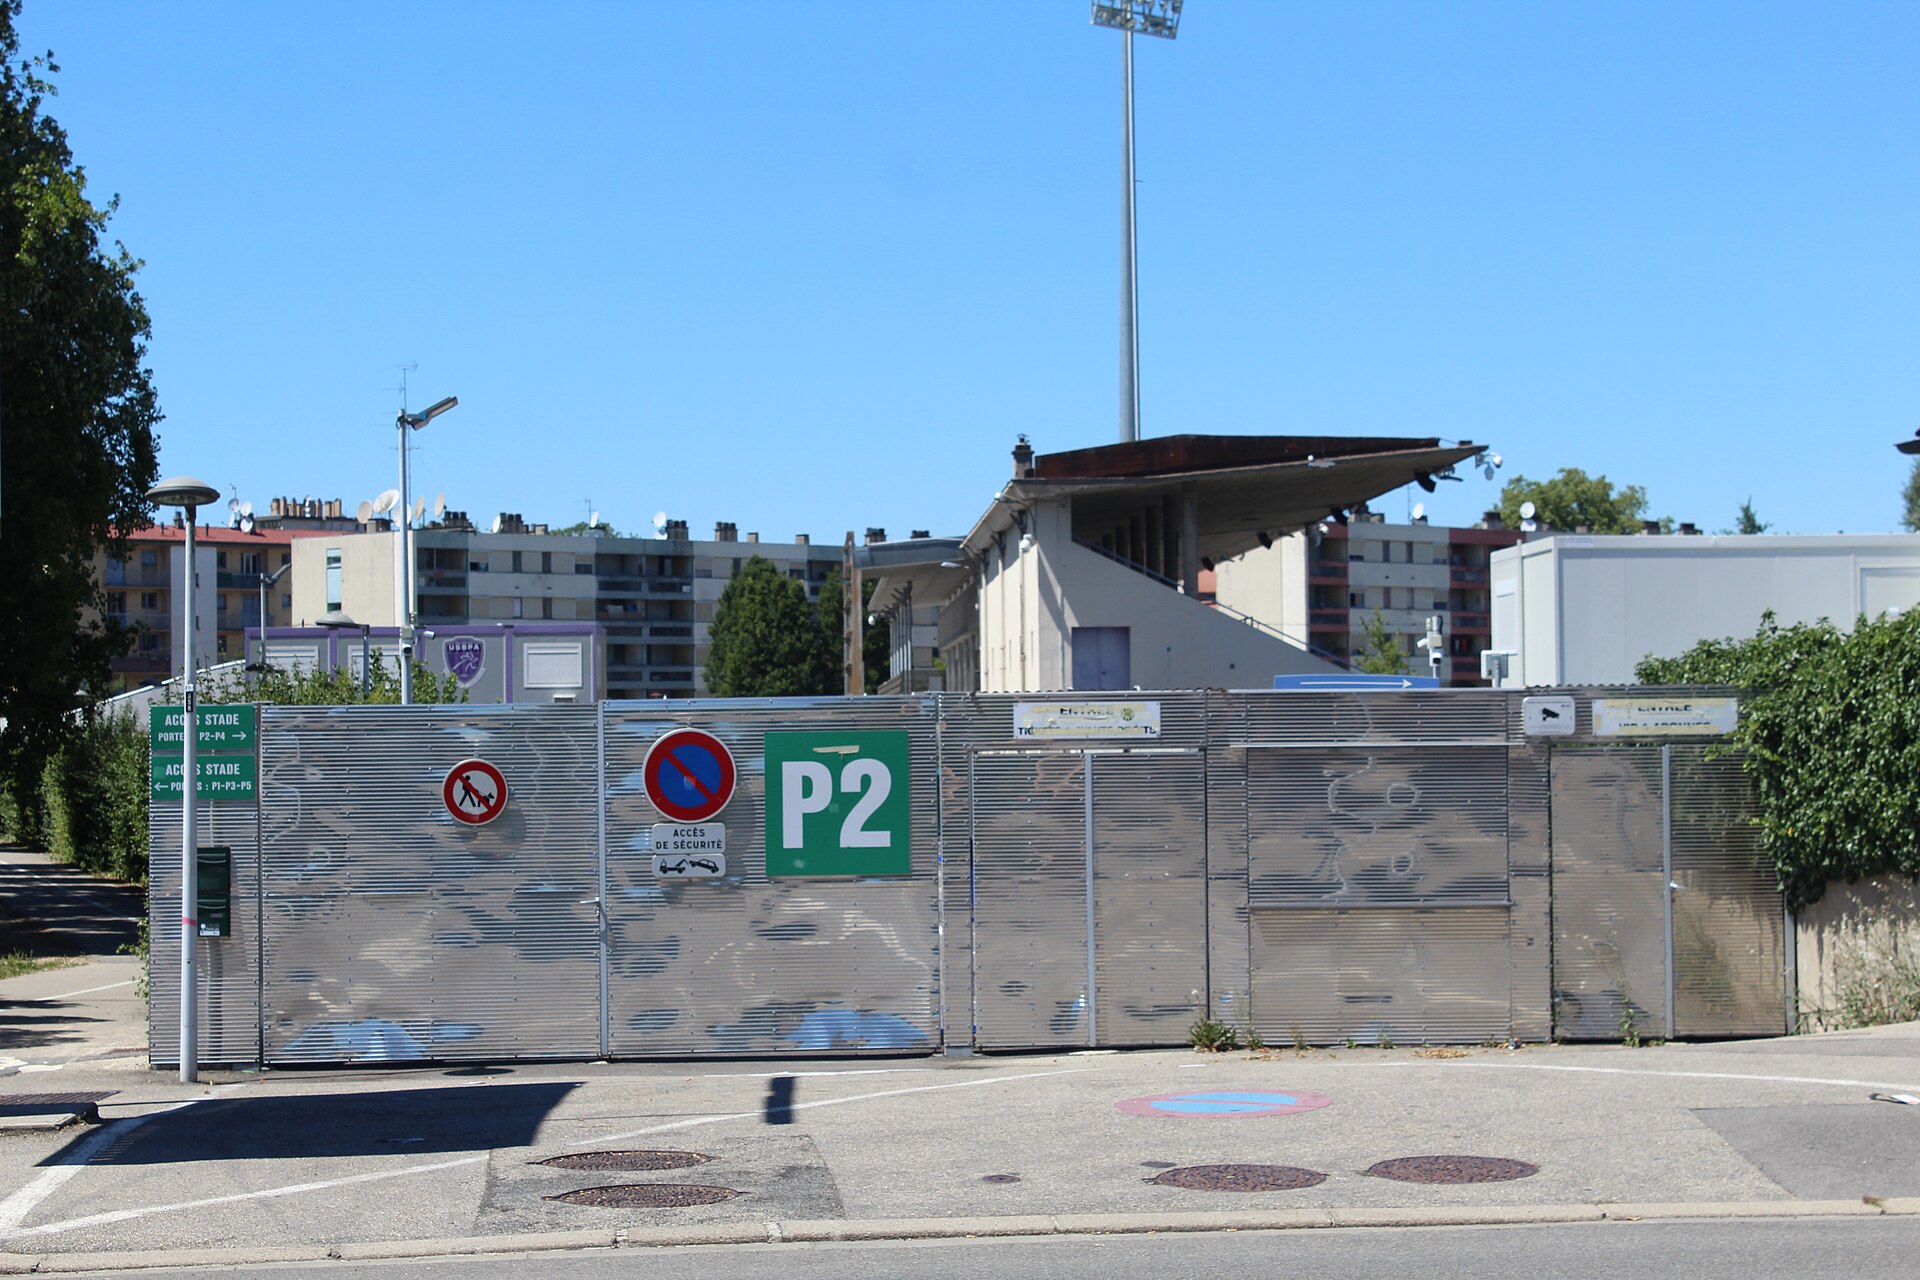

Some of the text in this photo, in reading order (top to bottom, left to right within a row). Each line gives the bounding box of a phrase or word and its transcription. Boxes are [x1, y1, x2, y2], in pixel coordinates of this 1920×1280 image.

[165, 713, 240, 726] ACCS STADE
[158, 731, 225, 742] PORTE P2-P4
[165, 763, 240, 775] ACCS STADE
[211, 780, 252, 791] P1-P3-P5
[782, 757, 892, 849] P2
[673, 827, 706, 838] ACCÈS
[655, 839, 723, 850] DE SÉCURITÉ
